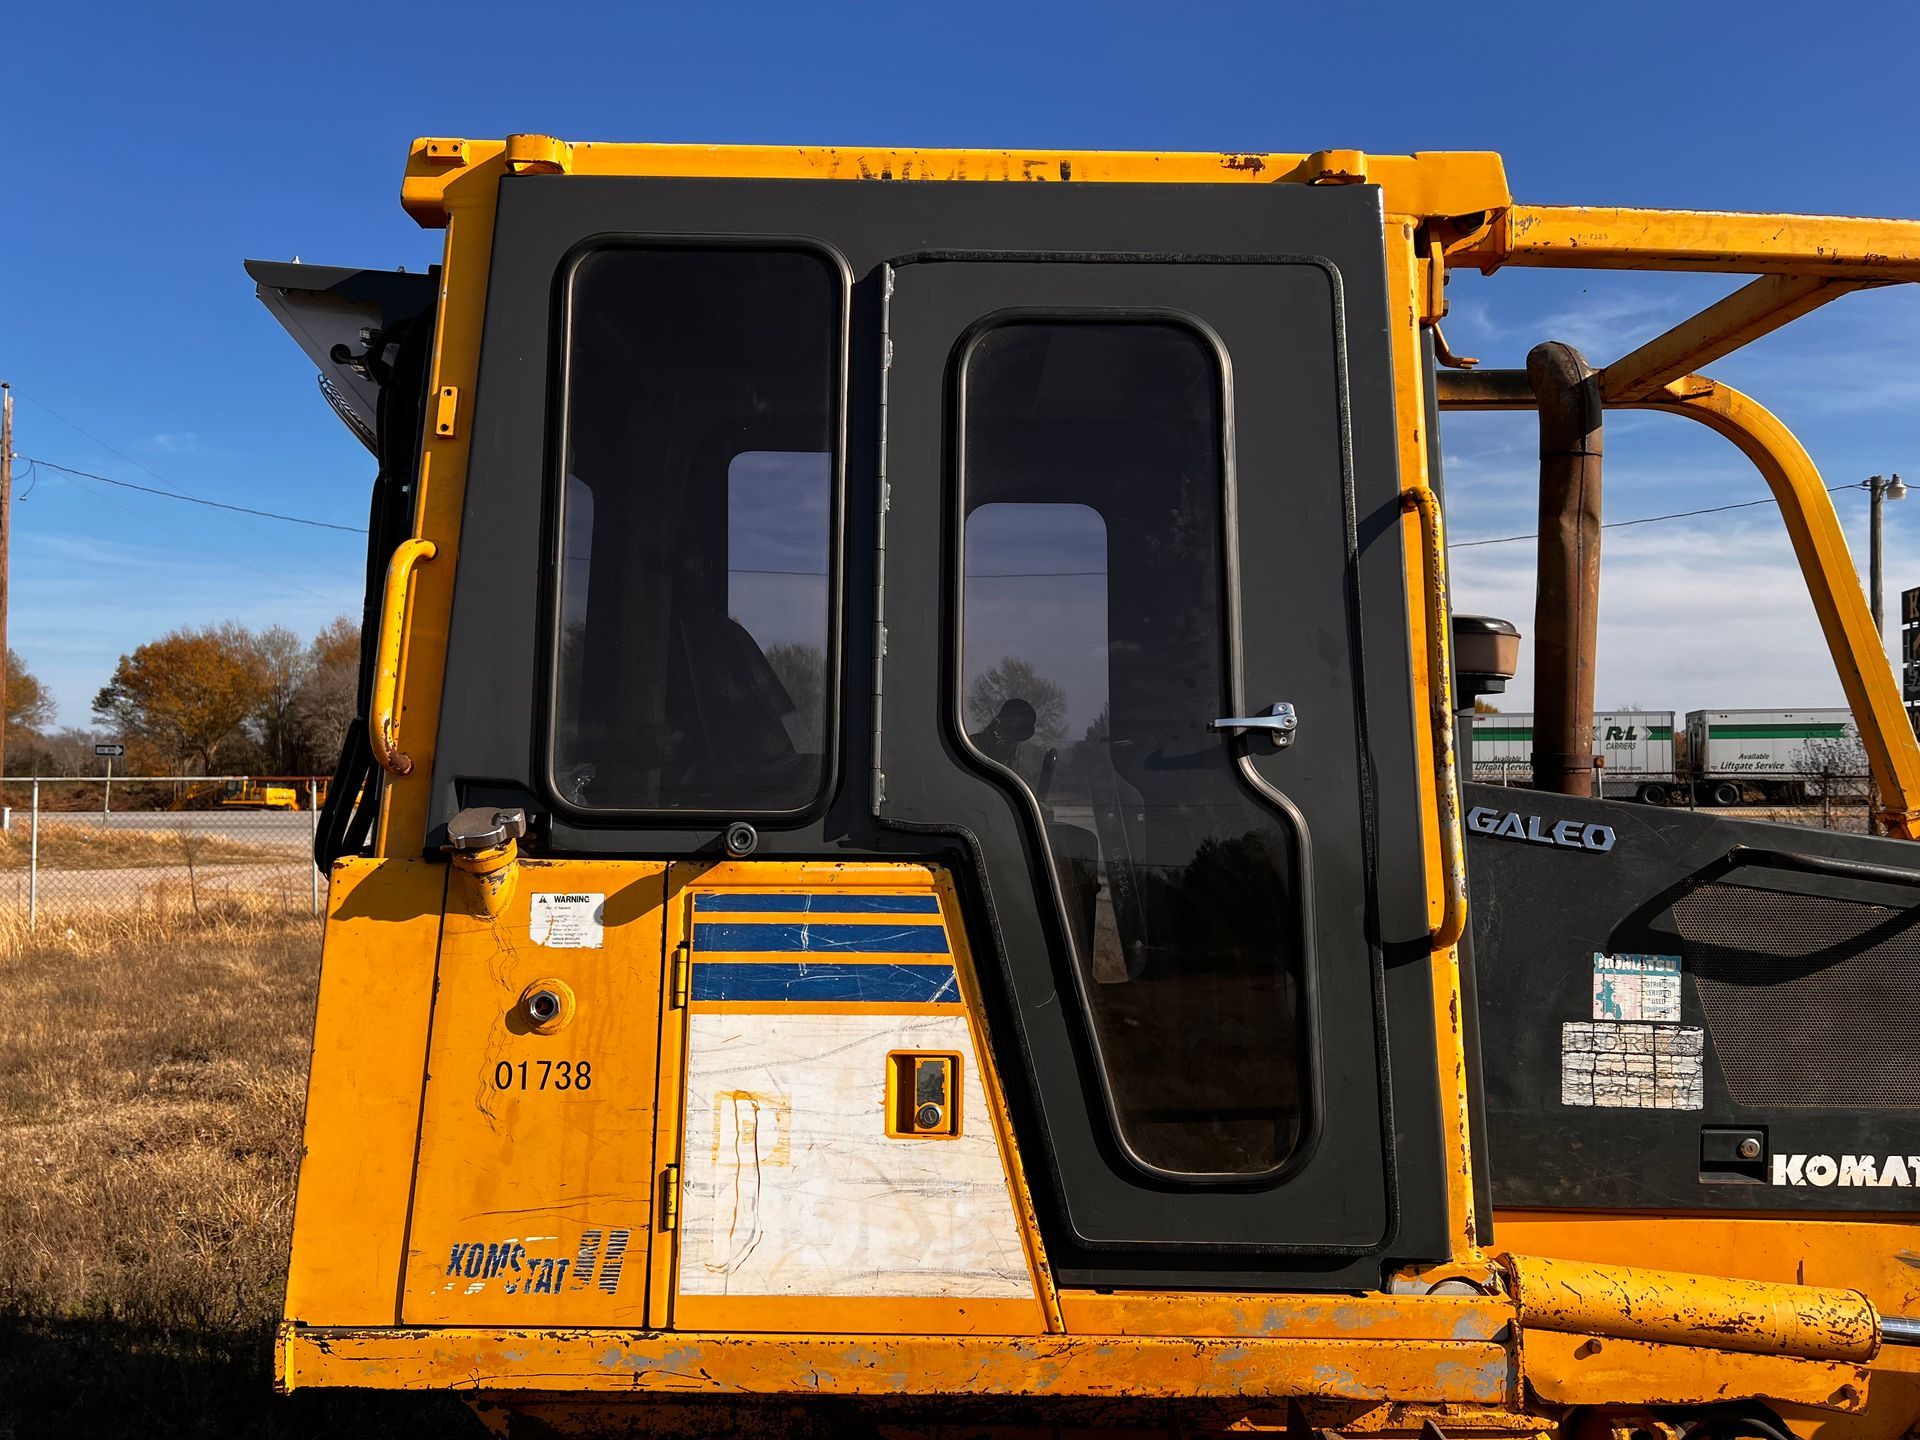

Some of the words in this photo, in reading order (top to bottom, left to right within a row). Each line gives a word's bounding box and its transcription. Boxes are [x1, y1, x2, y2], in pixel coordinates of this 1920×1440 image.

[1606, 742, 1637, 750] CARRIERS
[1720, 761, 1753, 771] Liftgate
[1755, 761, 1785, 770] Service
[1467, 806, 1617, 852] GALEO
[553, 895, 590, 904] WARNING
[494, 1060, 592, 1091] 01738
